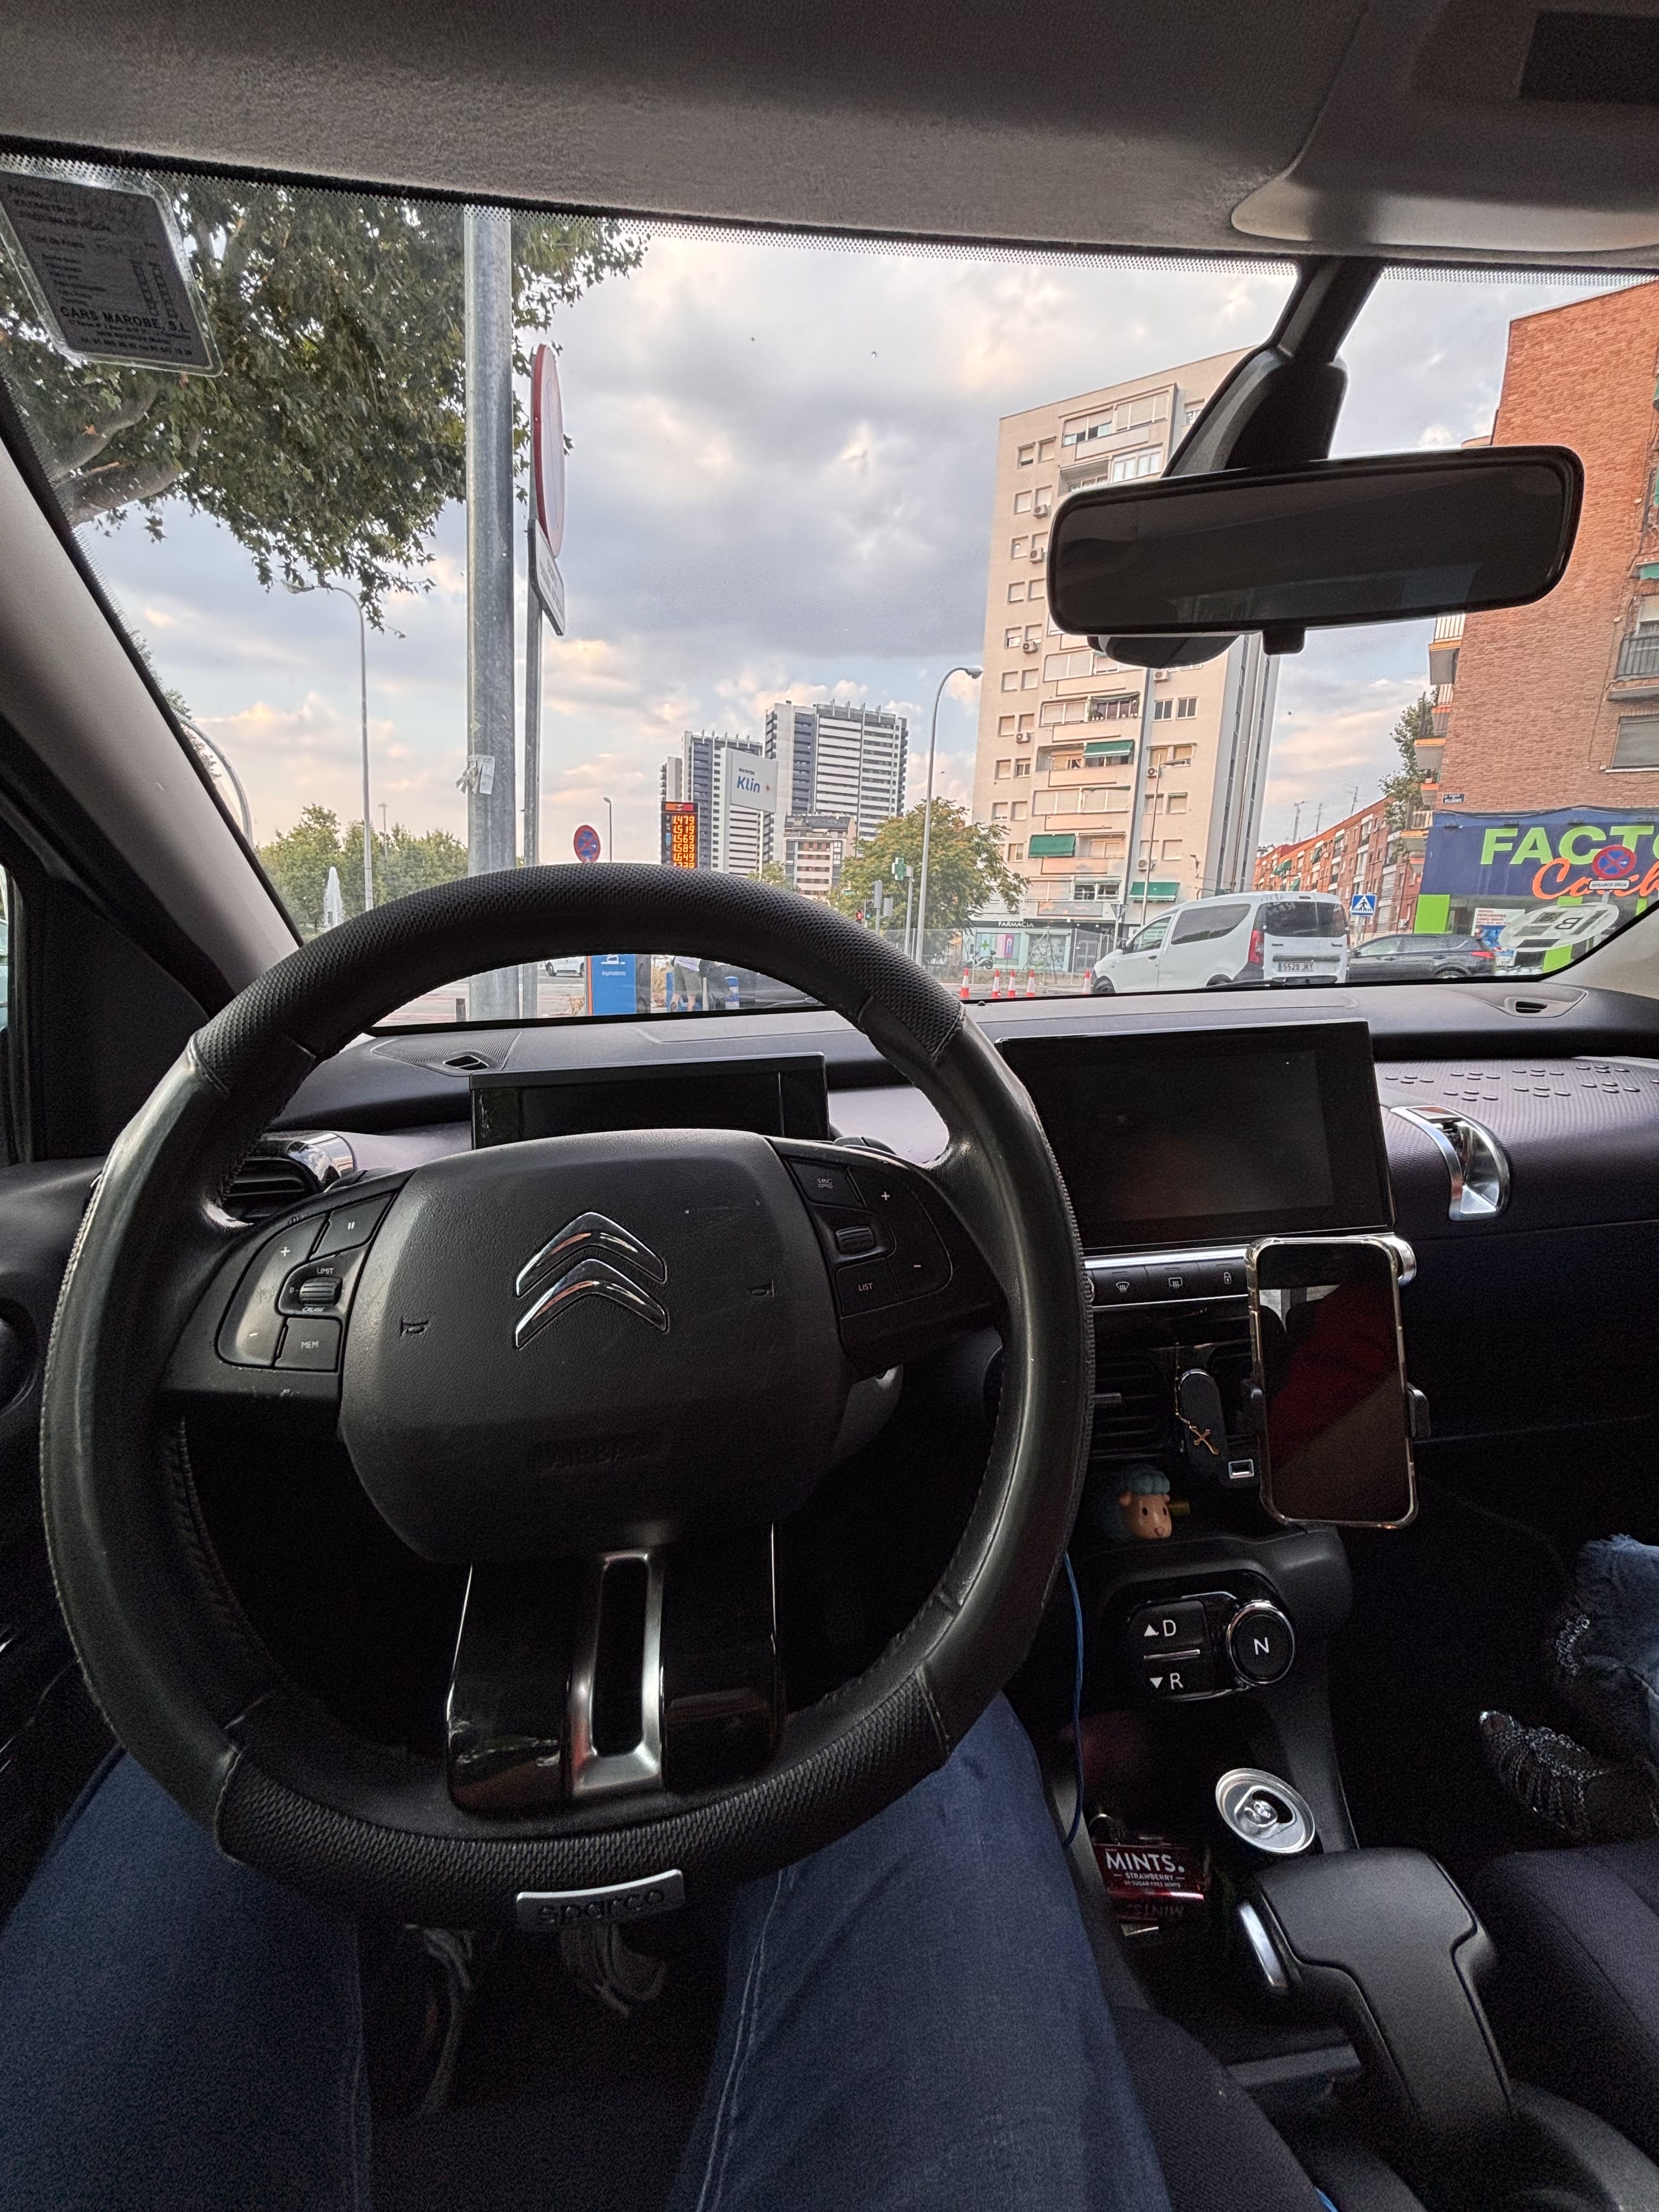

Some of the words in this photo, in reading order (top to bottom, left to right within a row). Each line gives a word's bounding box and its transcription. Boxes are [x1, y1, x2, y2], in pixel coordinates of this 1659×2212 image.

[60, 306, 99, 320] CARS
[102, 312, 166, 331] MAROBE,
[737, 776, 760, 793] Klin
[1481, 826, 1659, 865] FACT
[858, 1283, 873, 1291] LIST
[301, 1341, 319, 1349] MEM
[1163, 1620, 1176, 1637] D
[1254, 1637, 1269, 1655] N
[1170, 1672, 1183, 1690] R
[1105, 1851, 1185, 1873] MINTS.
[1125, 1872, 1174, 1881] STRAWBERRY
[538, 1889, 665, 1925] sparco
